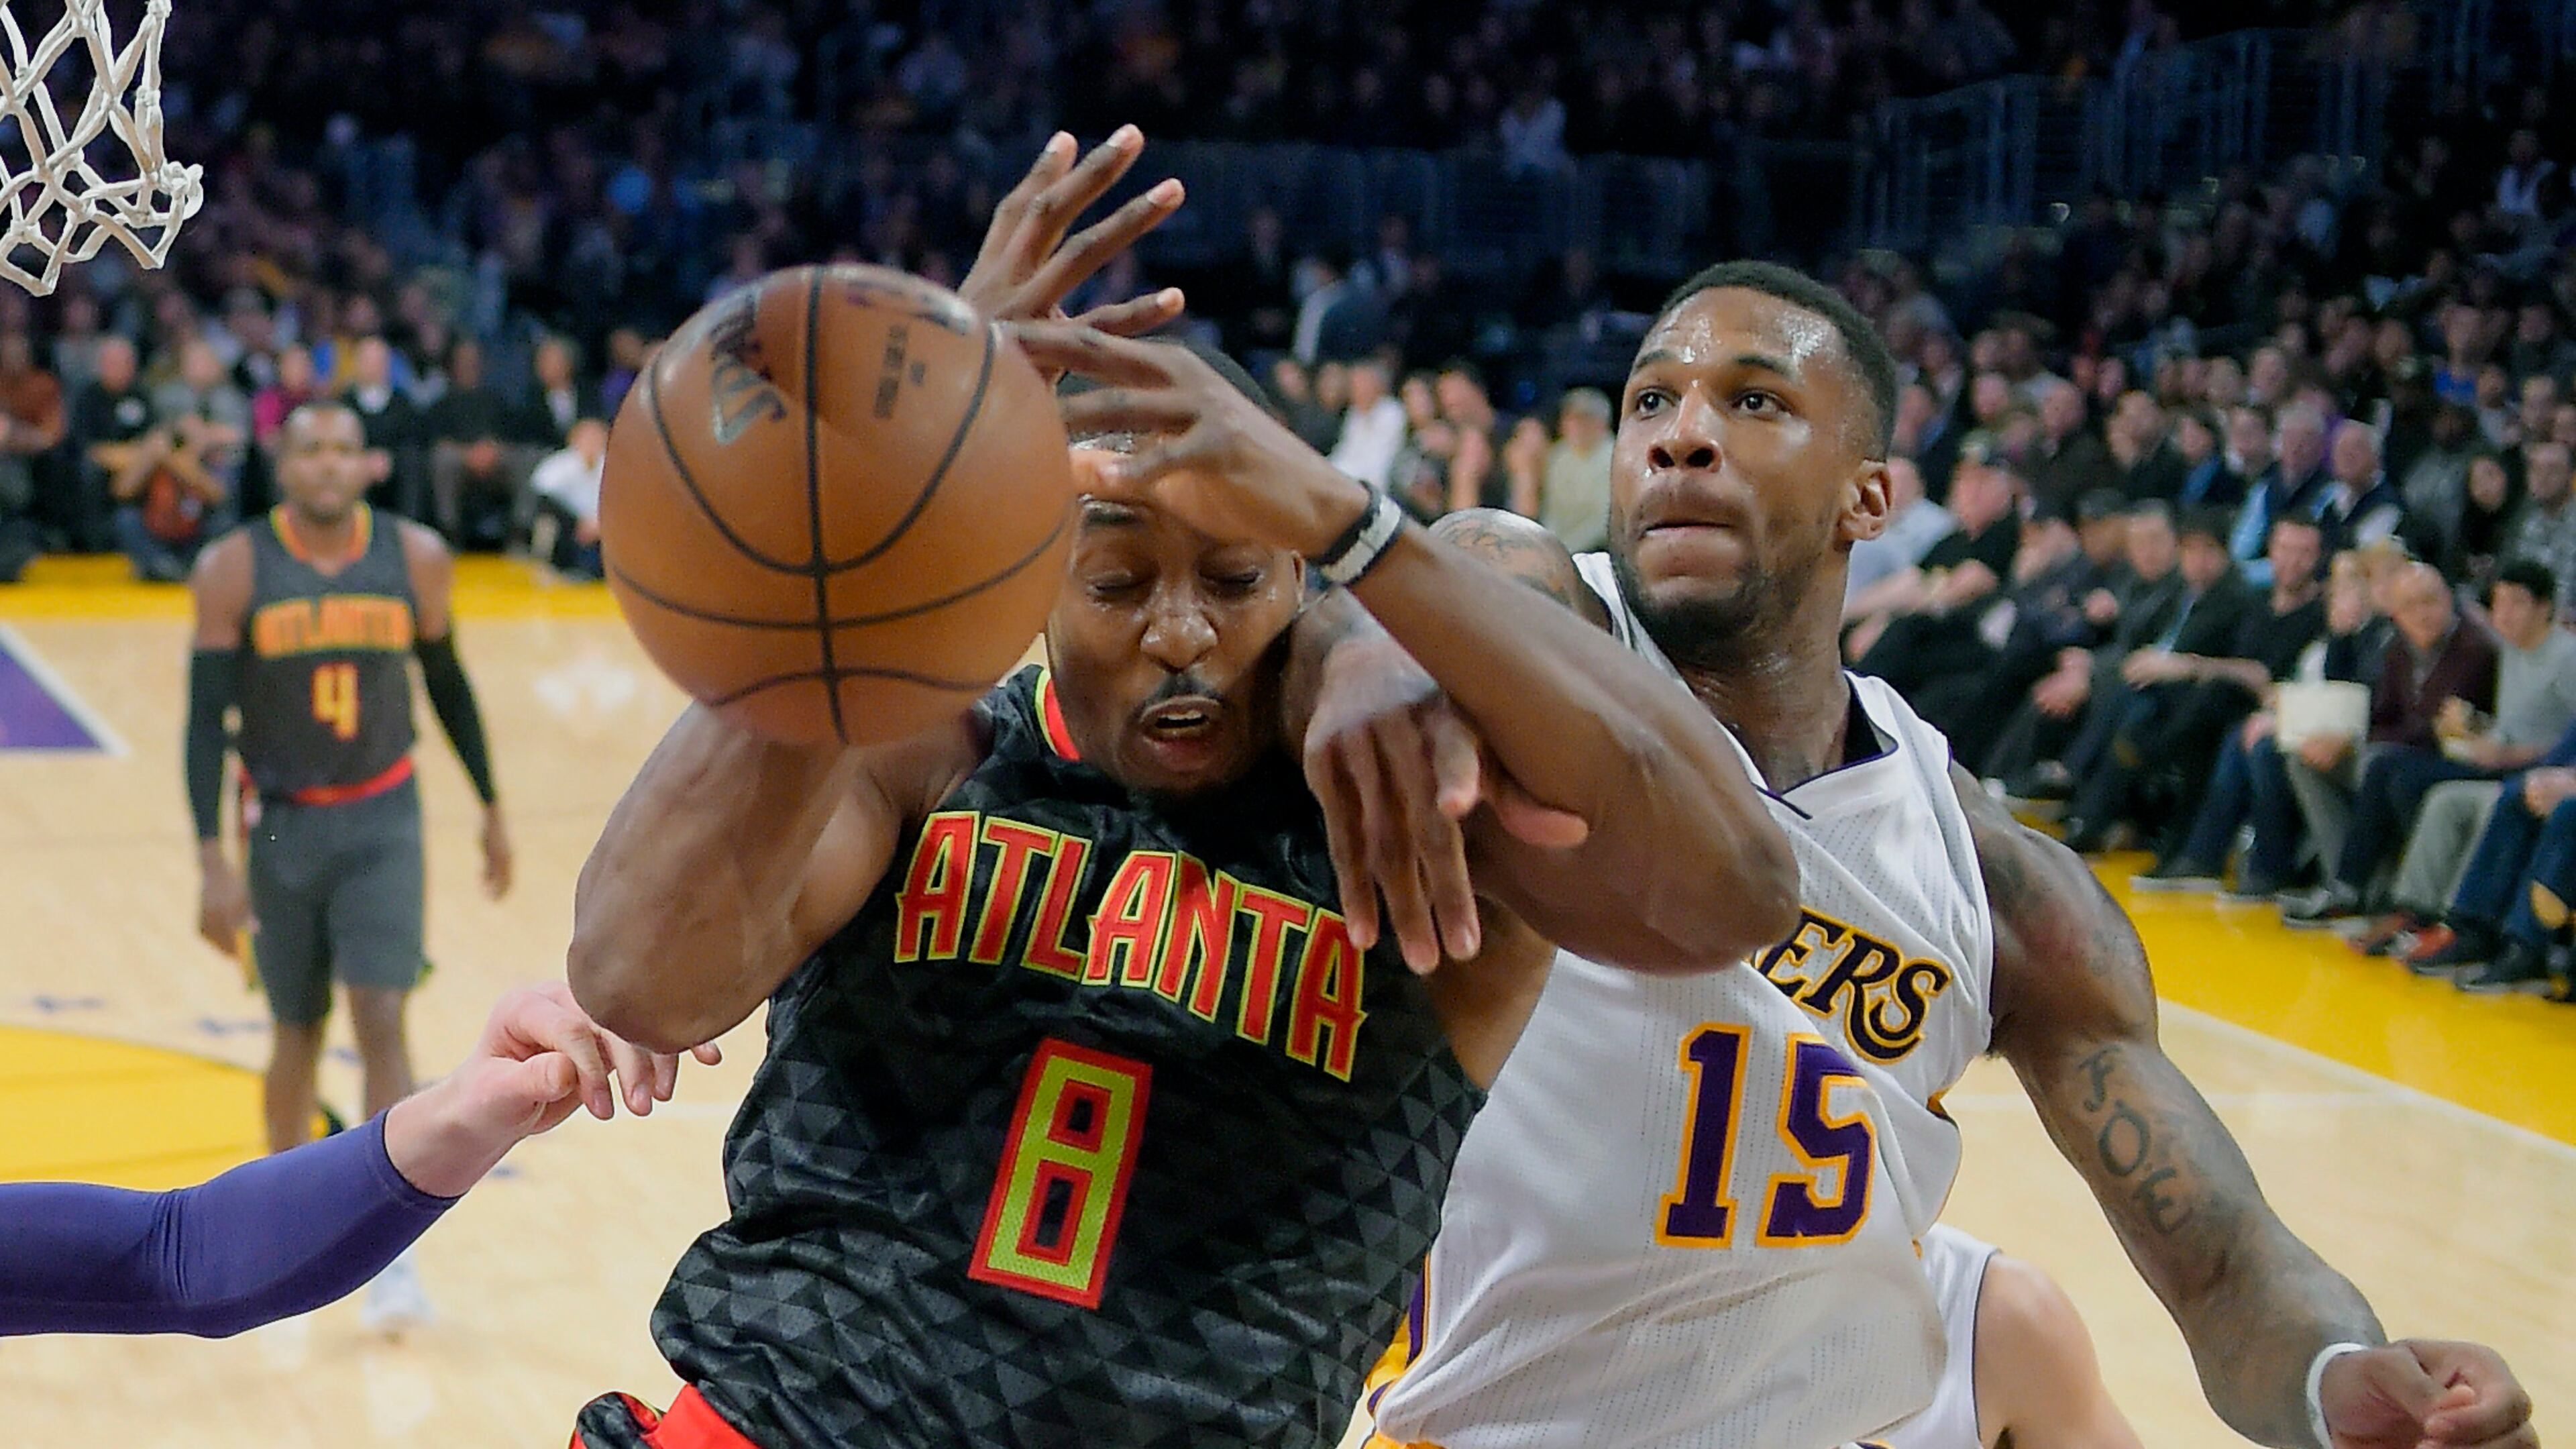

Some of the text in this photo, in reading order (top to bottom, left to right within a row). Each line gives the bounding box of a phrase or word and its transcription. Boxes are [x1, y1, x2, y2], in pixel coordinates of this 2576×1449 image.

[311, 661, 360, 741] 4
[894, 810, 1368, 1082] ATLANTA
[1750, 906, 1953, 1065] ERS
[967, 1037, 1153, 1309] 8
[1655, 1021, 1877, 1249] 15
